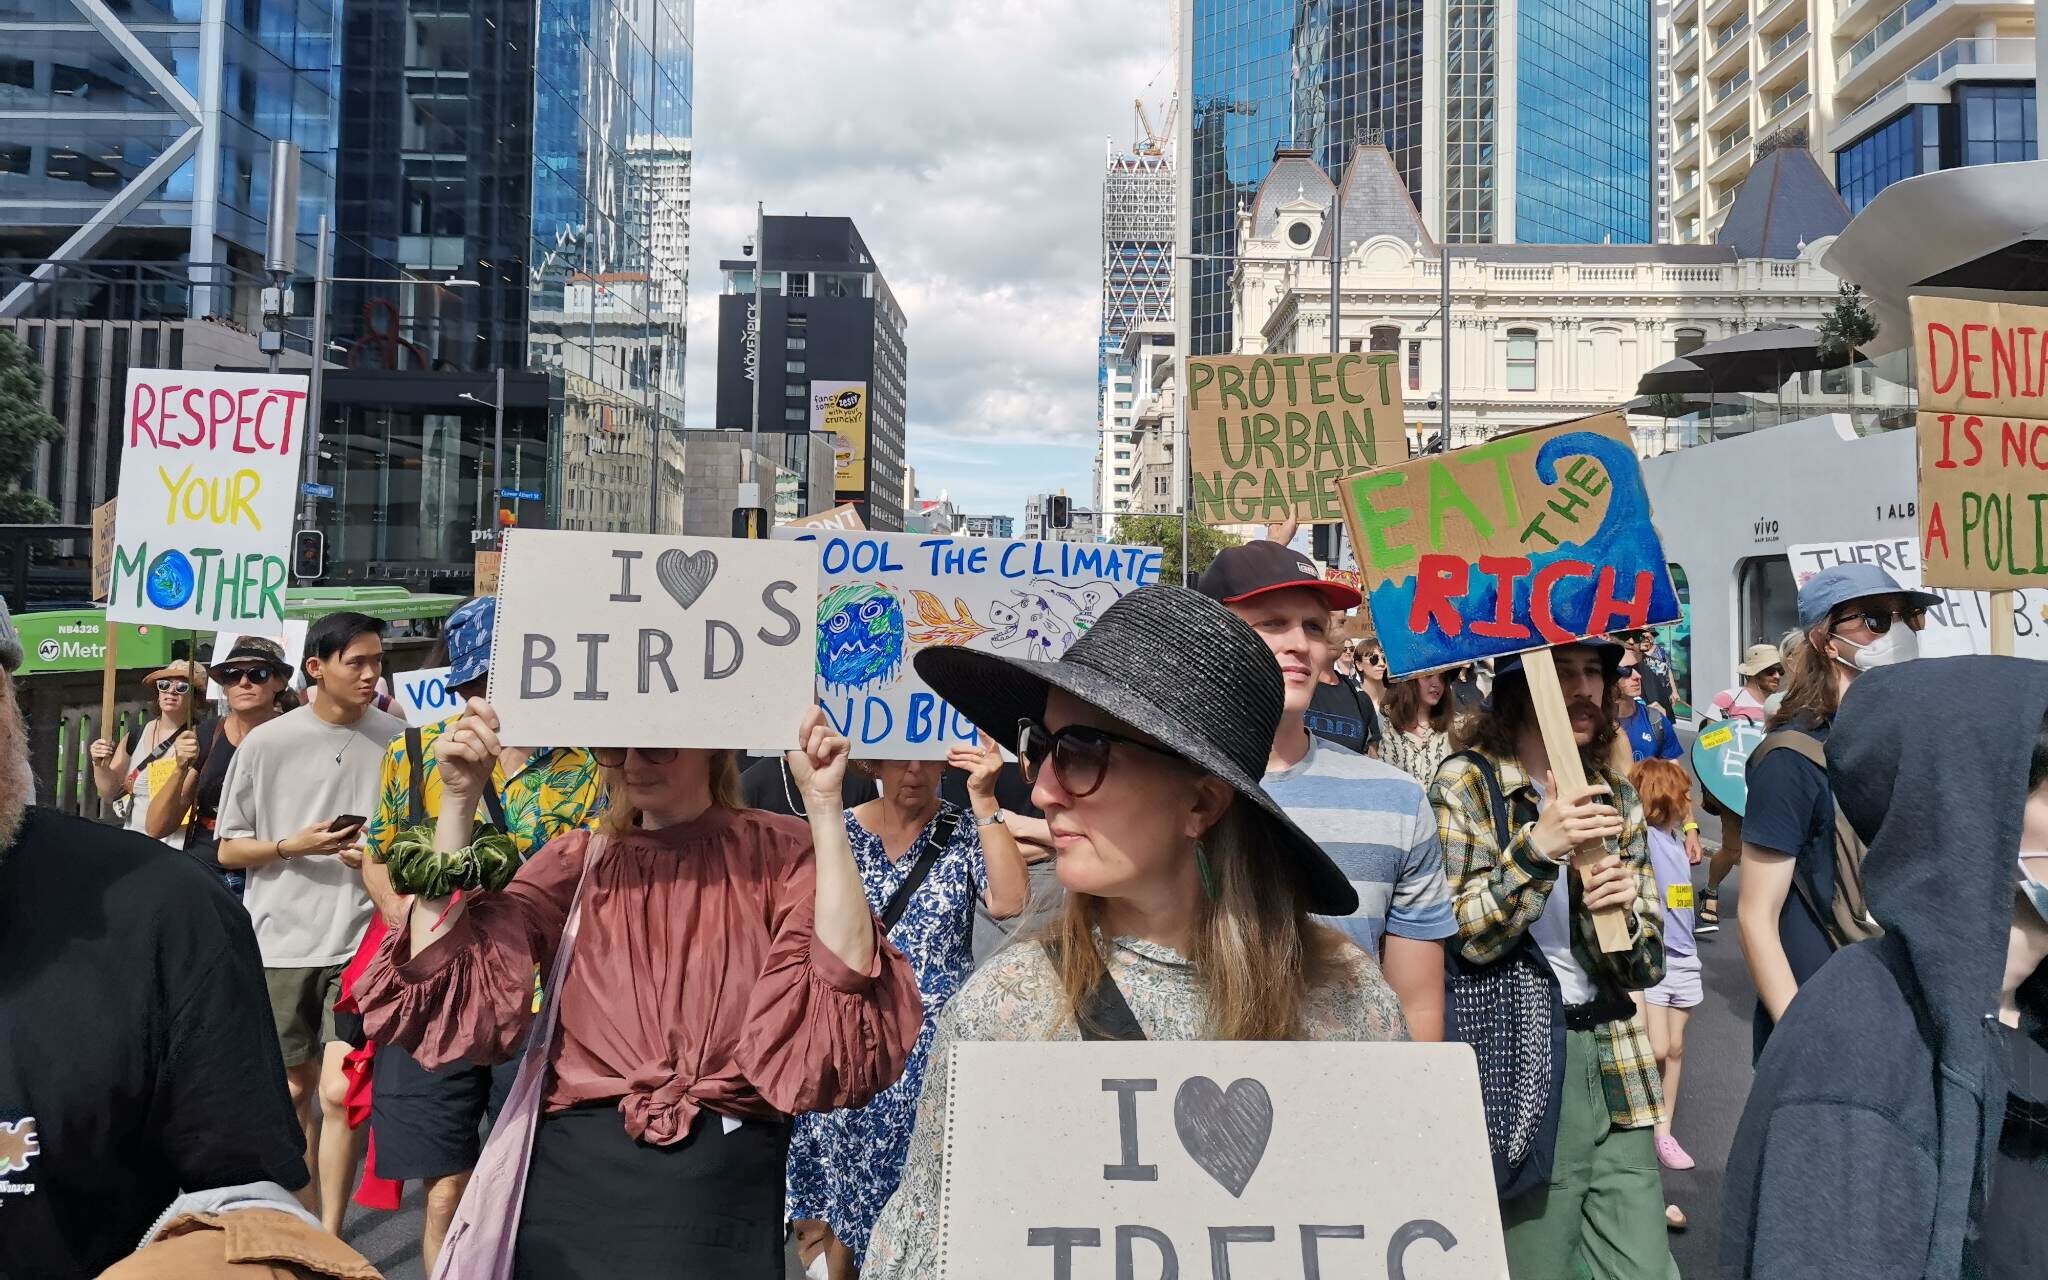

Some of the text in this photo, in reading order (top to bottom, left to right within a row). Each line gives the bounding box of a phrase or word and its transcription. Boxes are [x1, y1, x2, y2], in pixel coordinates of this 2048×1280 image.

[814, 395, 838, 403] fancy
[815, 394, 858, 410] some zesty
[1189, 353, 1399, 410] PROTECT
[130, 383, 306, 455] RESPECT
[825, 412, 862, 424] crunchy?
[843, 408, 858, 416] your
[1218, 407, 1377, 470] URBAN
[1935, 415, 1985, 469] IS
[158, 464, 261, 531] YOUR
[1194, 465, 1373, 522] NGAHE
[1351, 435, 1607, 571] EAT THE
[1876, 502, 1915, 521] 1 ALB
[1754, 516, 1779, 536] vivo
[1924, 501, 1949, 560] A
[110, 541, 285, 622] MOTHER
[609, 550, 643, 602] I
[793, 535, 1163, 586] OOL THE CLIMATE
[1800, 540, 1916, 572] THERE
[1409, 553, 1654, 644] RICH
[58, 624, 100, 634] NB4326
[63, 641, 108, 658] Metr
[520, 580, 801, 701] BIRDS
[1101, 1078, 1158, 1181] I
